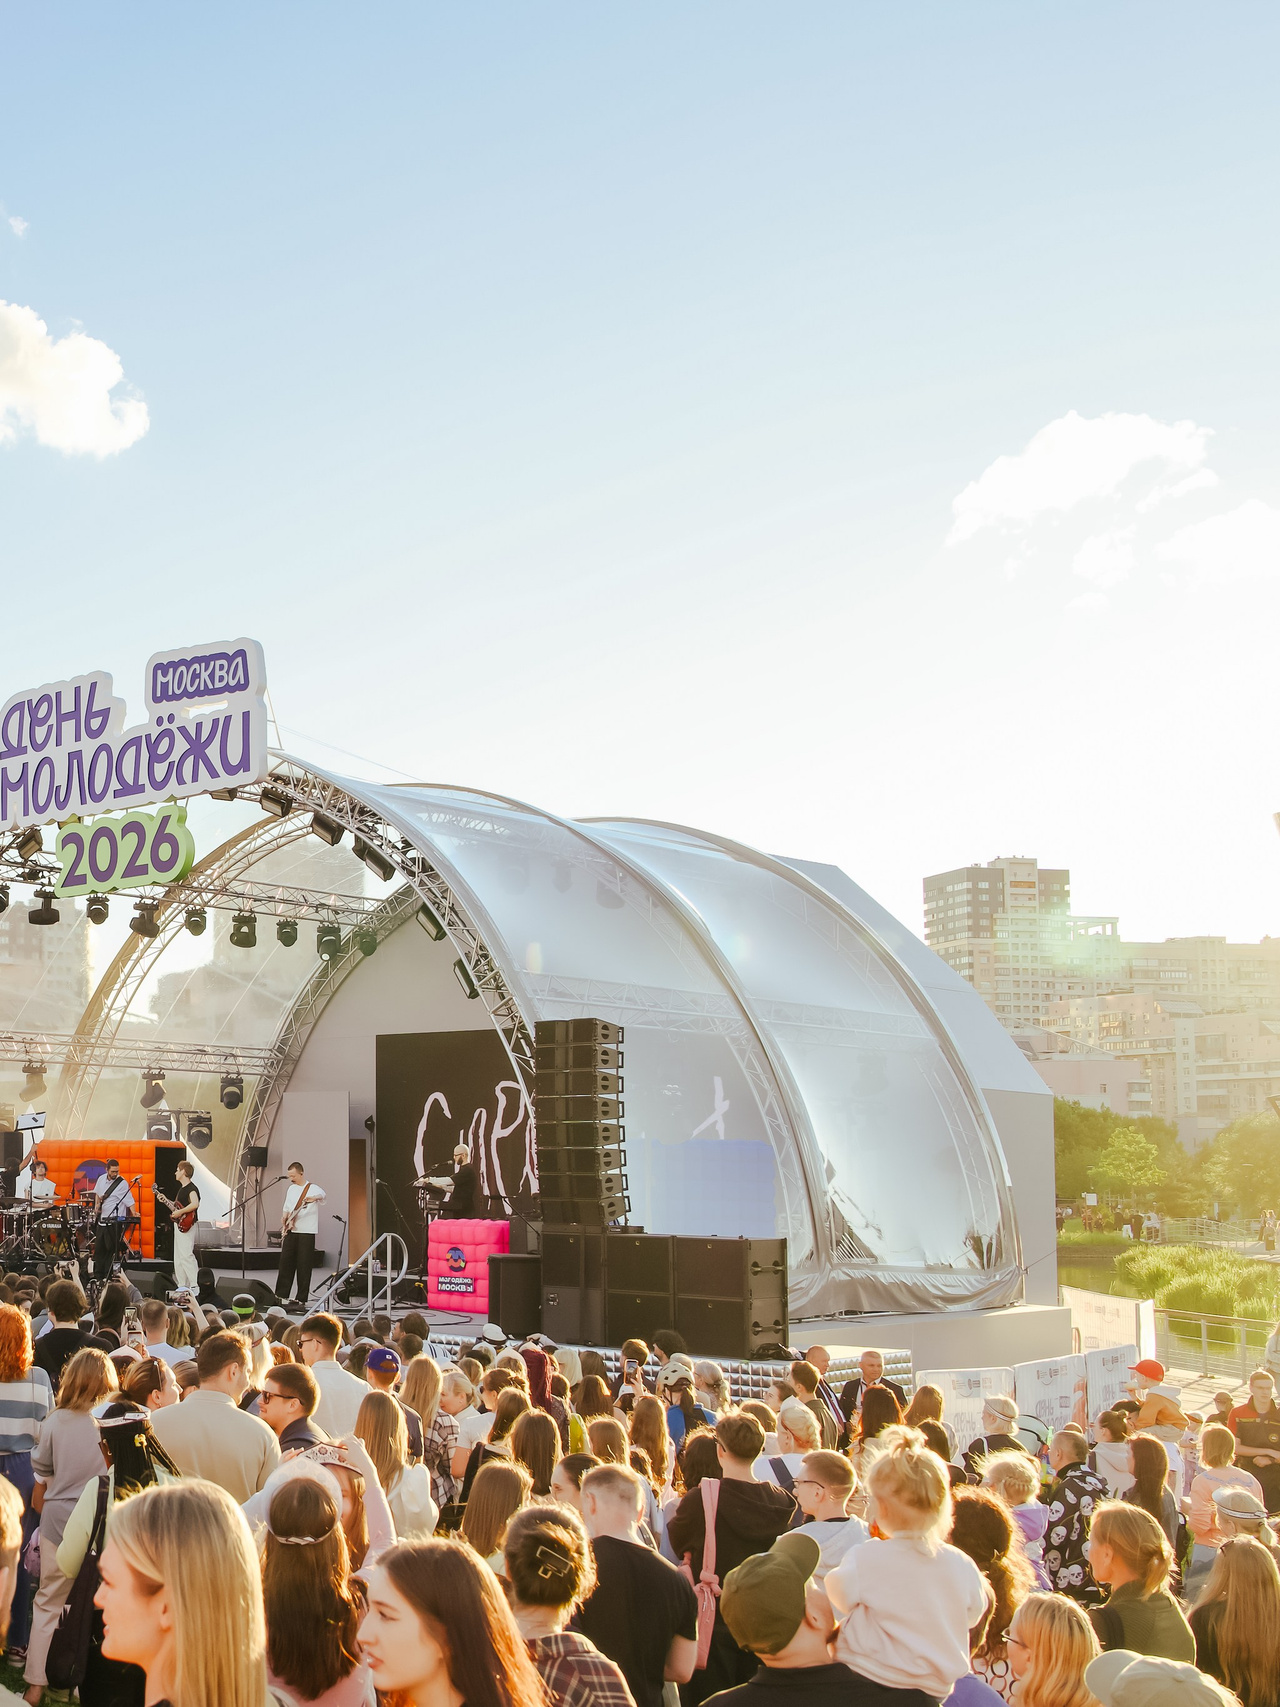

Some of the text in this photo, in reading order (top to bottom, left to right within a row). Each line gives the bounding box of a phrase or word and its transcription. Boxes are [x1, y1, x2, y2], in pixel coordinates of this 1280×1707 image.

[156, 656, 245, 698] МОСКВА
[0, 681, 111, 760] ДЕНЬ
[0, 710, 251, 822] МОЛОДЁЖИ
[60, 814, 180, 888] 2026
[438, 1283, 473, 1292] МОСКВЫ
